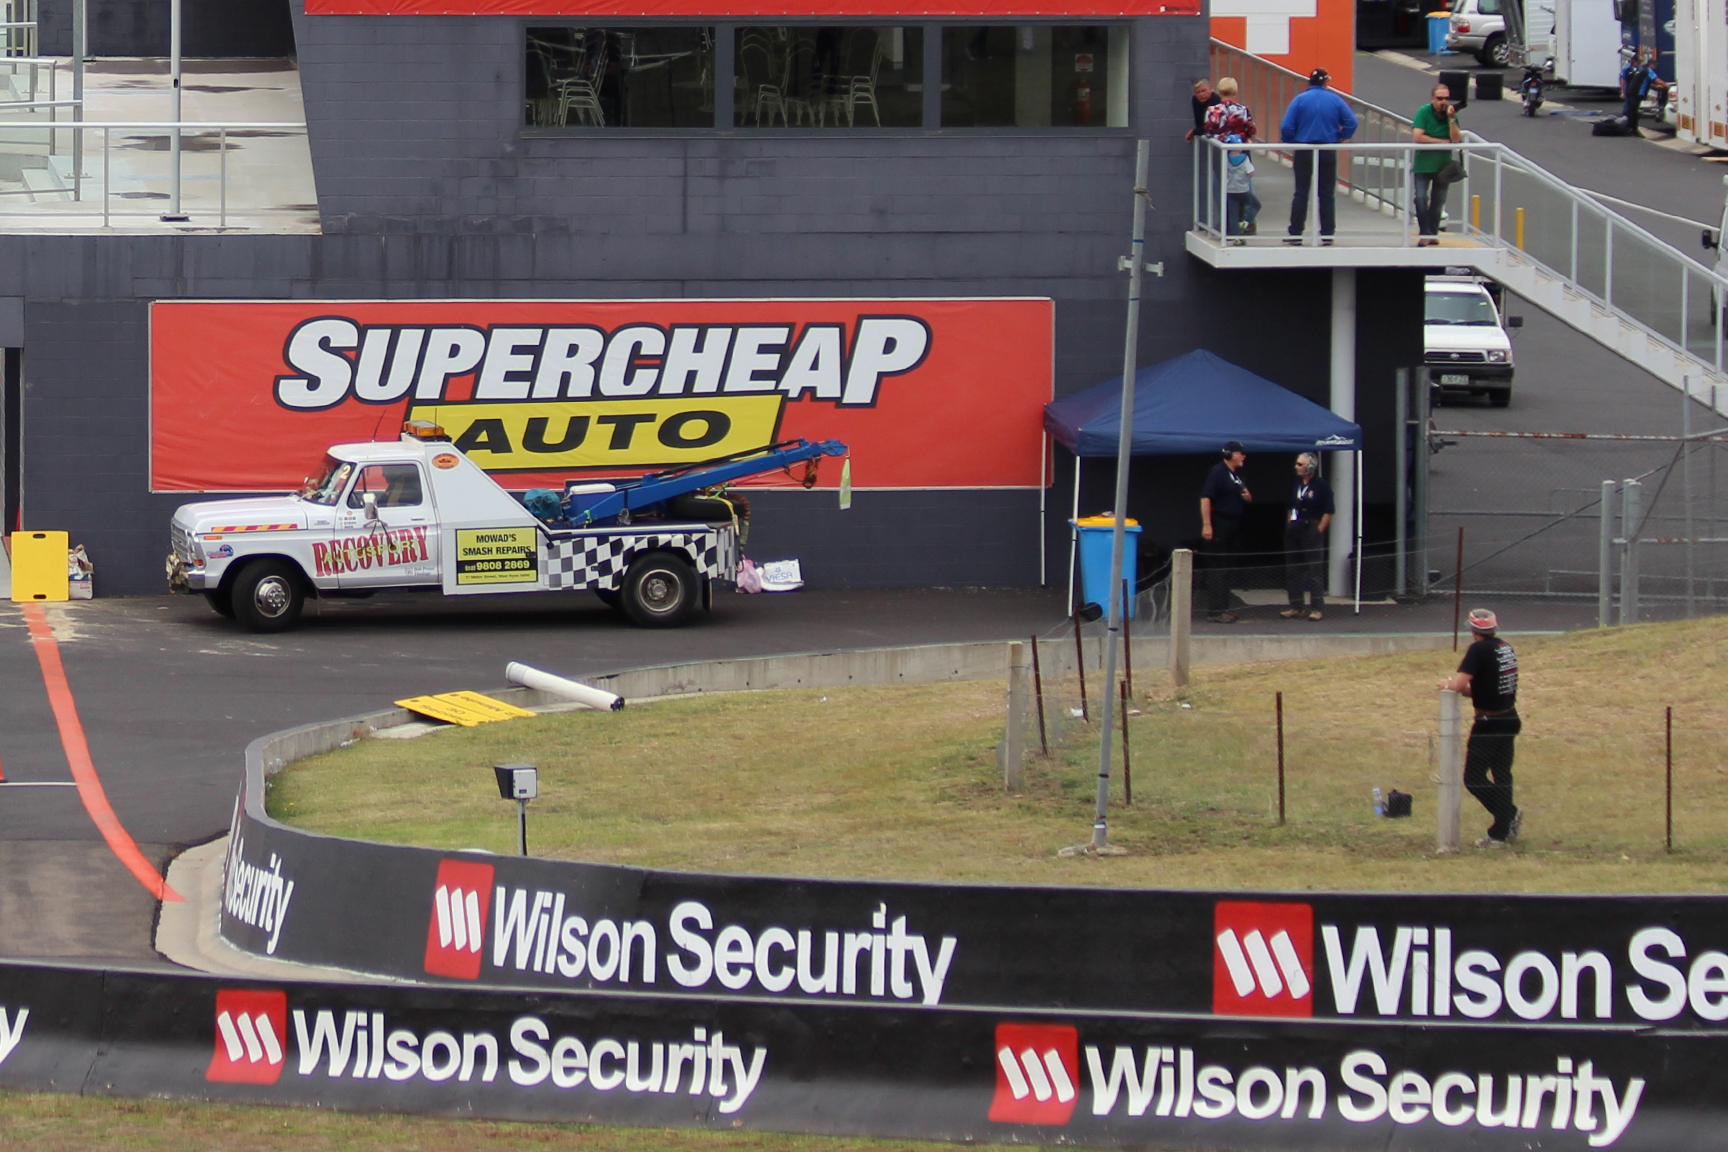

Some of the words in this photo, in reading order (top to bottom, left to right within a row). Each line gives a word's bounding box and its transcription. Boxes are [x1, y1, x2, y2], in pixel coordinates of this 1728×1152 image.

[278, 319, 928, 407] SUPERCHEAP
[452, 413, 732, 454] AUTO
[339, 464, 352, 480] 2
[312, 526, 429, 577] RECOVERY
[323, 538, 420, 564] AUTOSPORT
[462, 547, 493, 556] SMASH
[496, 545, 531, 555] REPAIRS
[476, 533, 517, 544] MOWAD'S
[476, 561, 502, 571] 9808
[504, 560, 530, 570] 2869
[493, 886, 657, 984] Wilson
[666, 901, 957, 1009] Security
[1322, 926, 1613, 1020] Wilson
[293, 1010, 499, 1084] Wilson
[508, 1017, 768, 1115] Security
[1085, 1047, 1327, 1120] Wilson
[1338, 1051, 1646, 1148] Security
